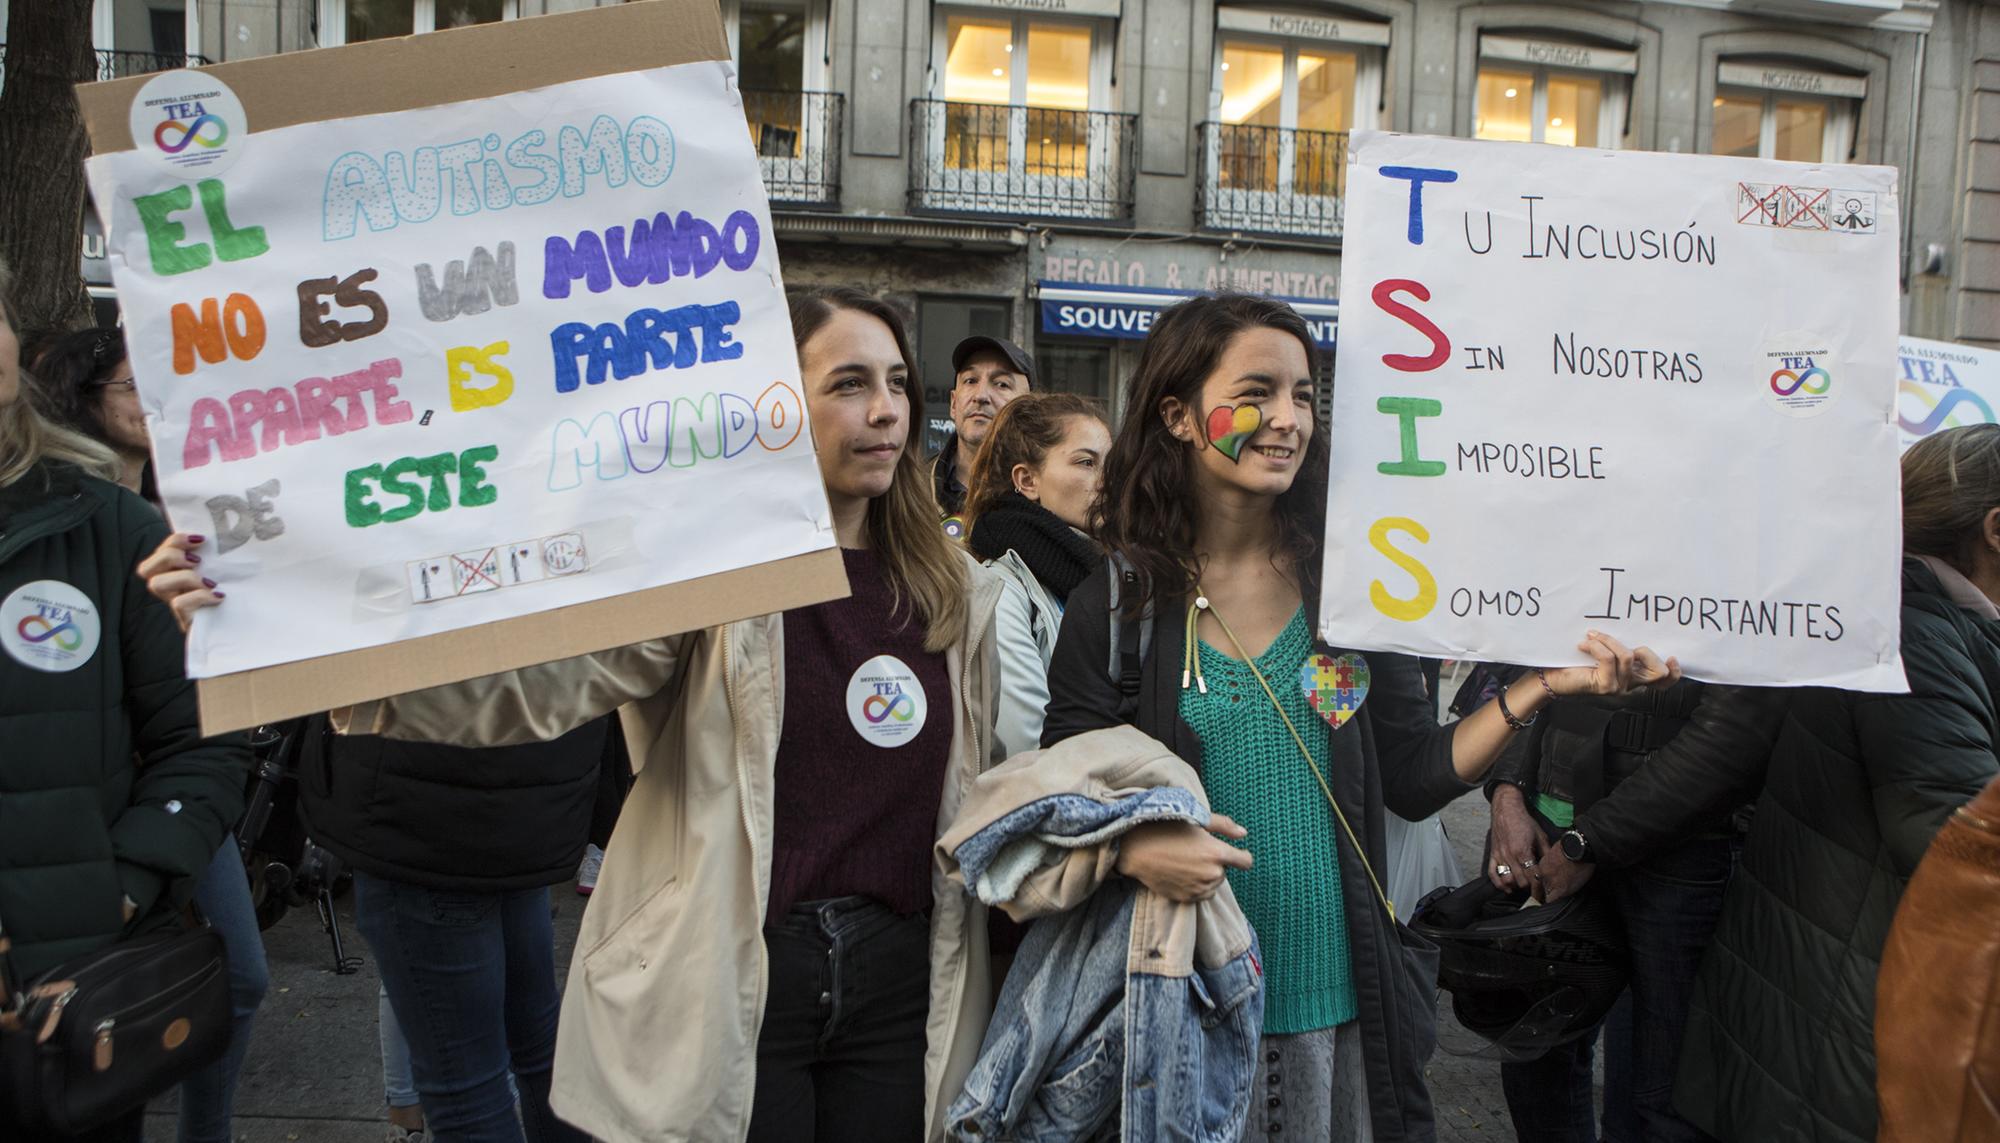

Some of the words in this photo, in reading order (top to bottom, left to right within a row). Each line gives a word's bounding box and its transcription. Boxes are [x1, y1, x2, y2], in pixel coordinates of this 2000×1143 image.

[163, 101, 207, 120] TEA
[132, 178, 270, 277] EL
[1521, 196, 1716, 266] INCLUSIÓN
[171, 293, 267, 376] NO
[297, 267, 389, 348] ES
[414, 241, 519, 322] UN
[543, 210, 760, 299] MUNDO
[1166, 261, 1183, 289] &
[1060, 305, 1161, 332] SOUVE
[1553, 332, 1704, 384] NOSOTRAS
[1781, 356, 1815, 369] TEA
[1898, 356, 1962, 387] TEA
[183, 357, 435, 470] APARTE,
[446, 340, 516, 414] ES
[550, 300, 744, 394] PARTE
[1376, 395, 1606, 480] IMPOSIBLE
[206, 478, 286, 555] DE
[344, 444, 500, 529] ESTE
[547, 380, 803, 492] MUNDO
[1368, 516, 1542, 622] SOMOS
[1583, 567, 1845, 642] IMPORTANTES
[37, 604, 72, 623] TEA
[873, 682, 903, 696] TEA
